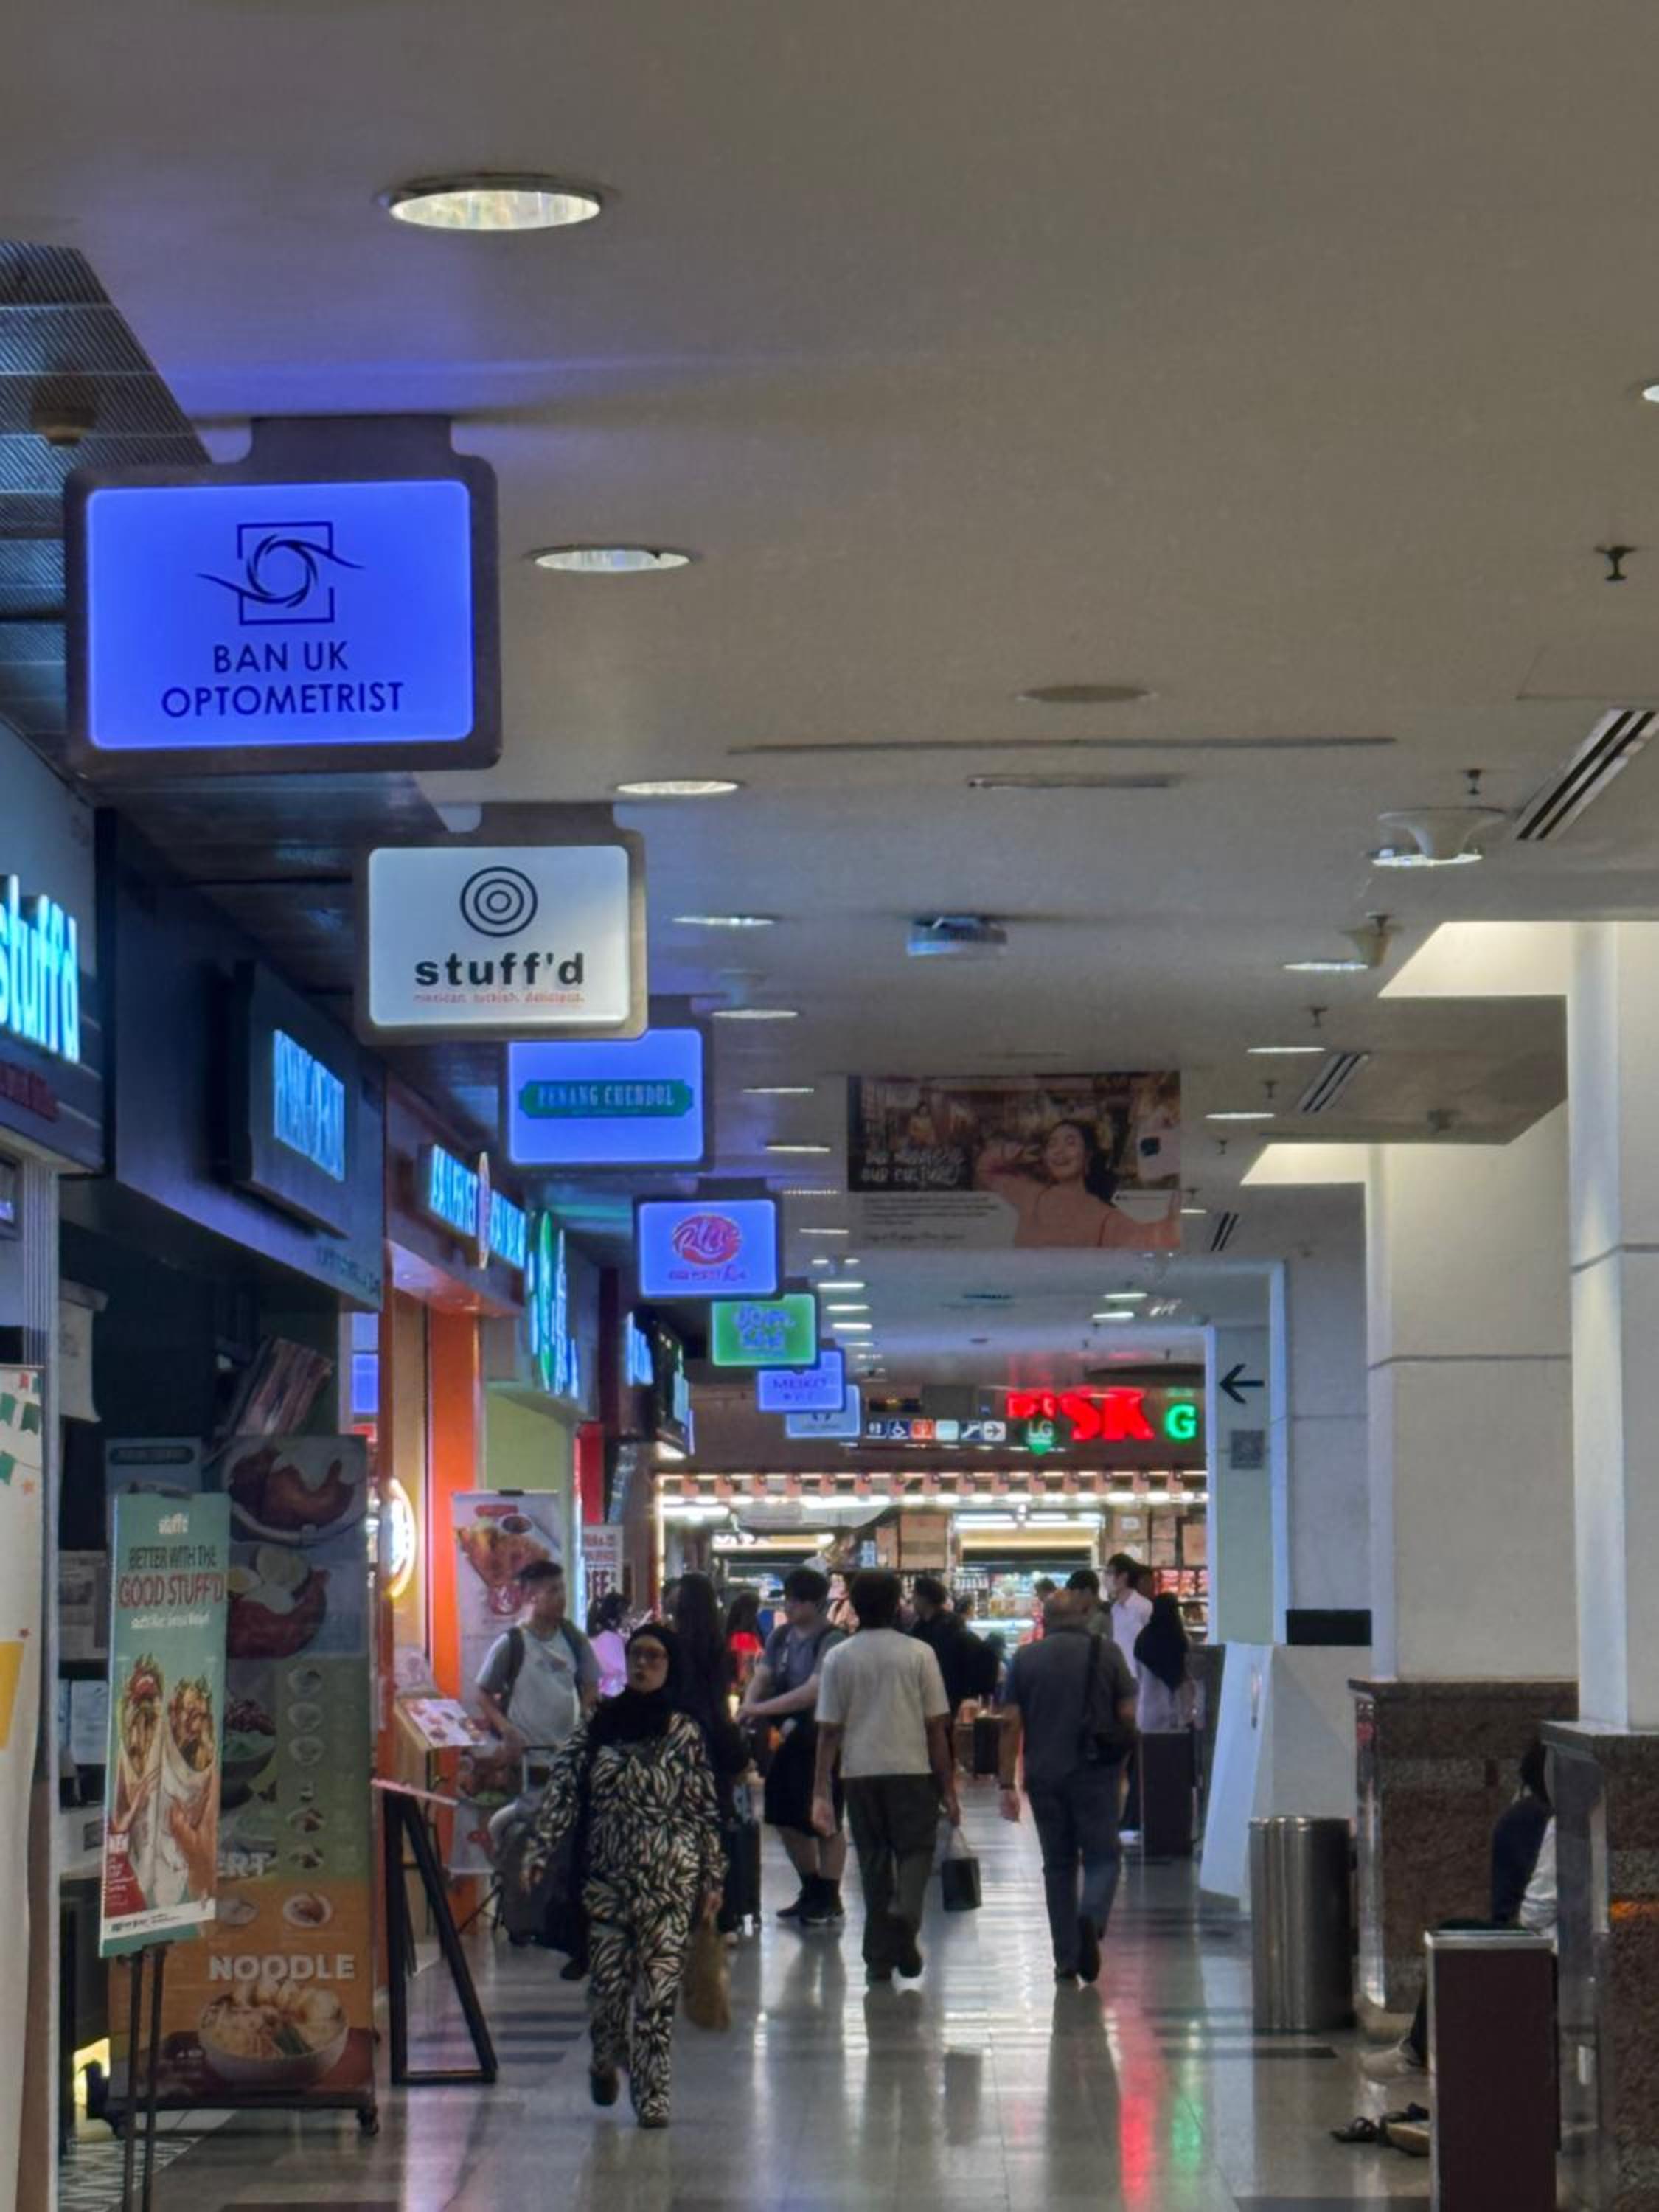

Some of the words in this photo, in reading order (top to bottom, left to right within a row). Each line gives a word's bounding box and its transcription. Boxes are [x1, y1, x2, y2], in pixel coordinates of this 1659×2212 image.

[213, 642, 288, 674] BAN
[303, 641, 349, 672] UK
[161, 681, 404, 718] OPTOMETRIST
[414, 951, 585, 986] stuff'd
[129, 1546, 167, 1570] BETTER
[170, 1545, 195, 1569] WITH
[197, 1545, 217, 1568] THE
[119, 1575, 166, 1608] GOOD
[167, 1572, 225, 1606] STUFF'D
[209, 1954, 355, 1980] NOODLE
